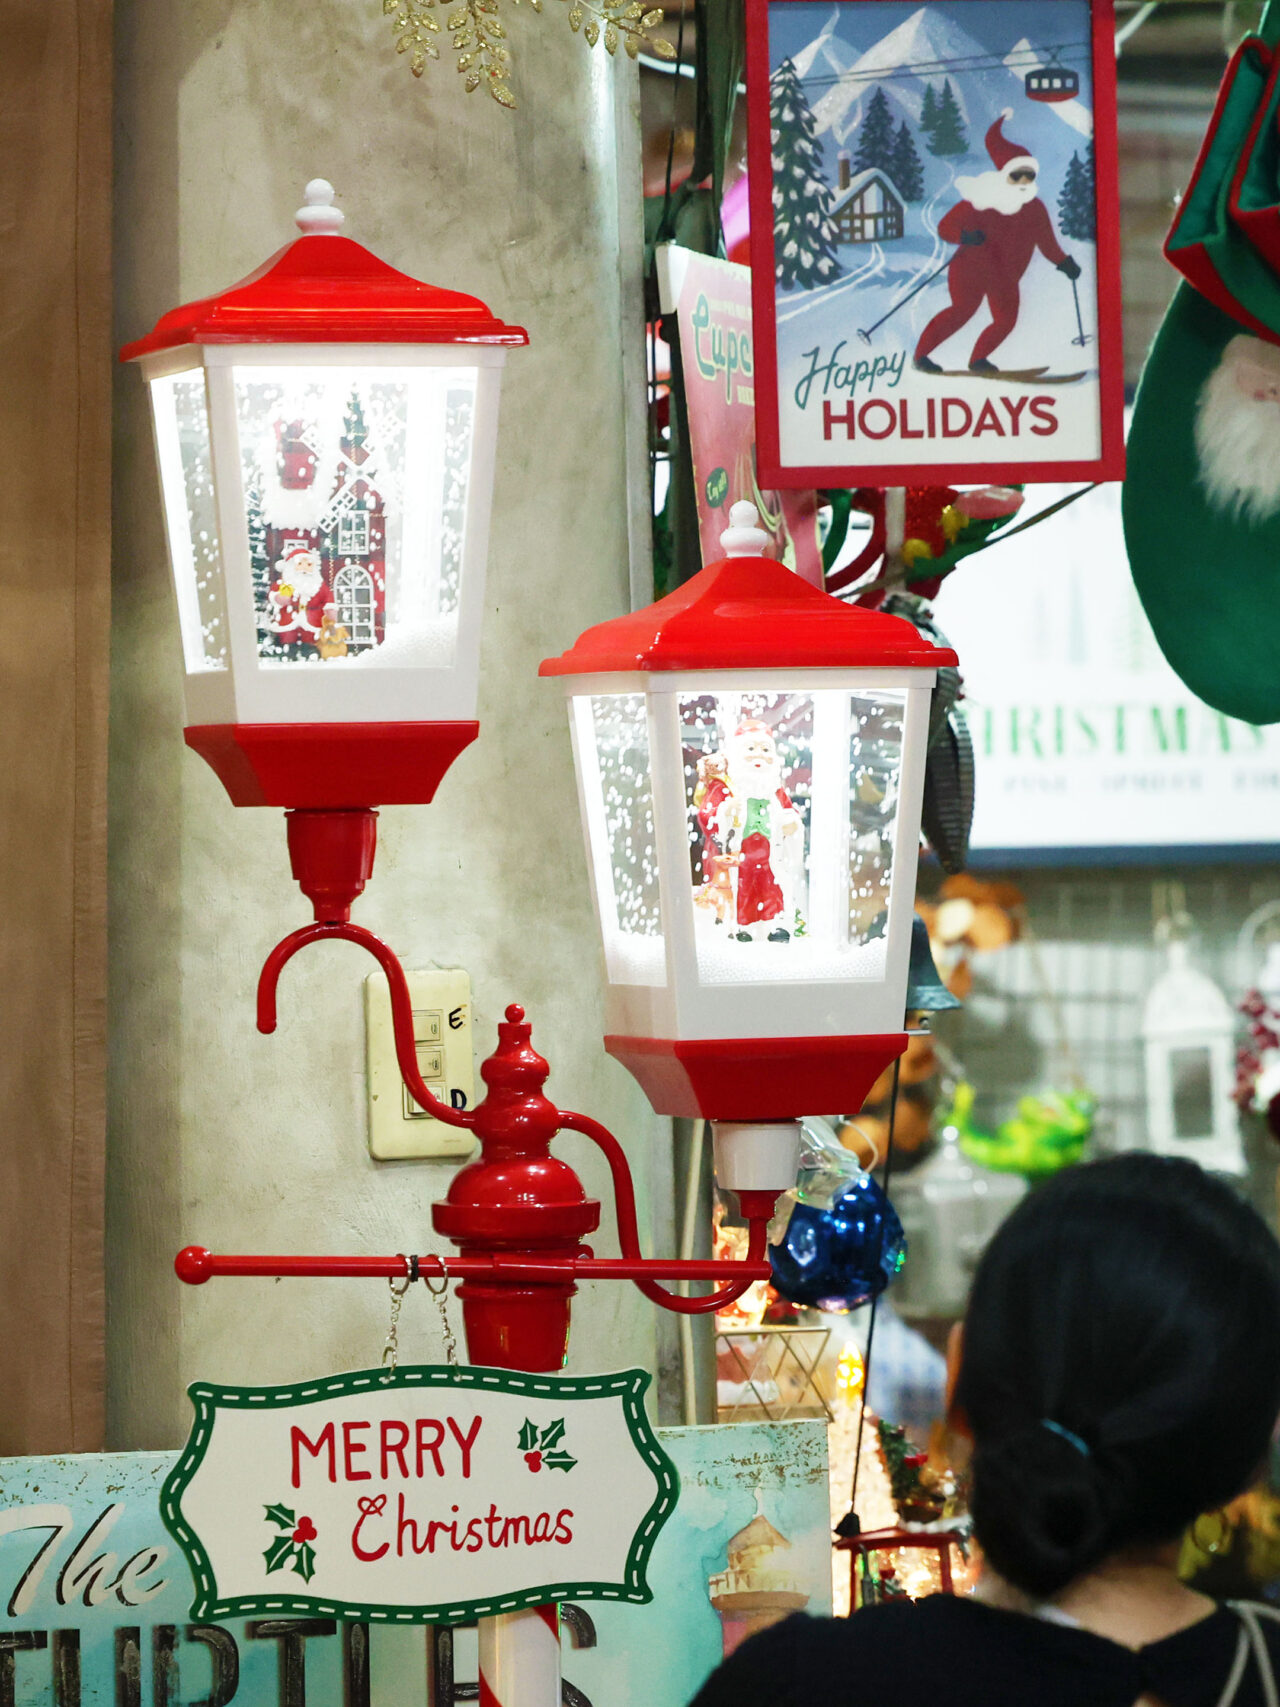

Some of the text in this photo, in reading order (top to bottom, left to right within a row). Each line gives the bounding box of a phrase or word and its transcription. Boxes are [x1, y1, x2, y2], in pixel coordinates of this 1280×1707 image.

[690, 290, 753, 406] Cupc
[794, 339, 907, 411] Happy
[822, 395, 1060, 441] HOLIDAYS
[448, 1006, 465, 1030] E
[450, 1088, 468, 1111] D
[290, 1414, 483, 1489] MERRY
[0, 1501, 173, 1618] The
[351, 1491, 575, 1563] Christmas
